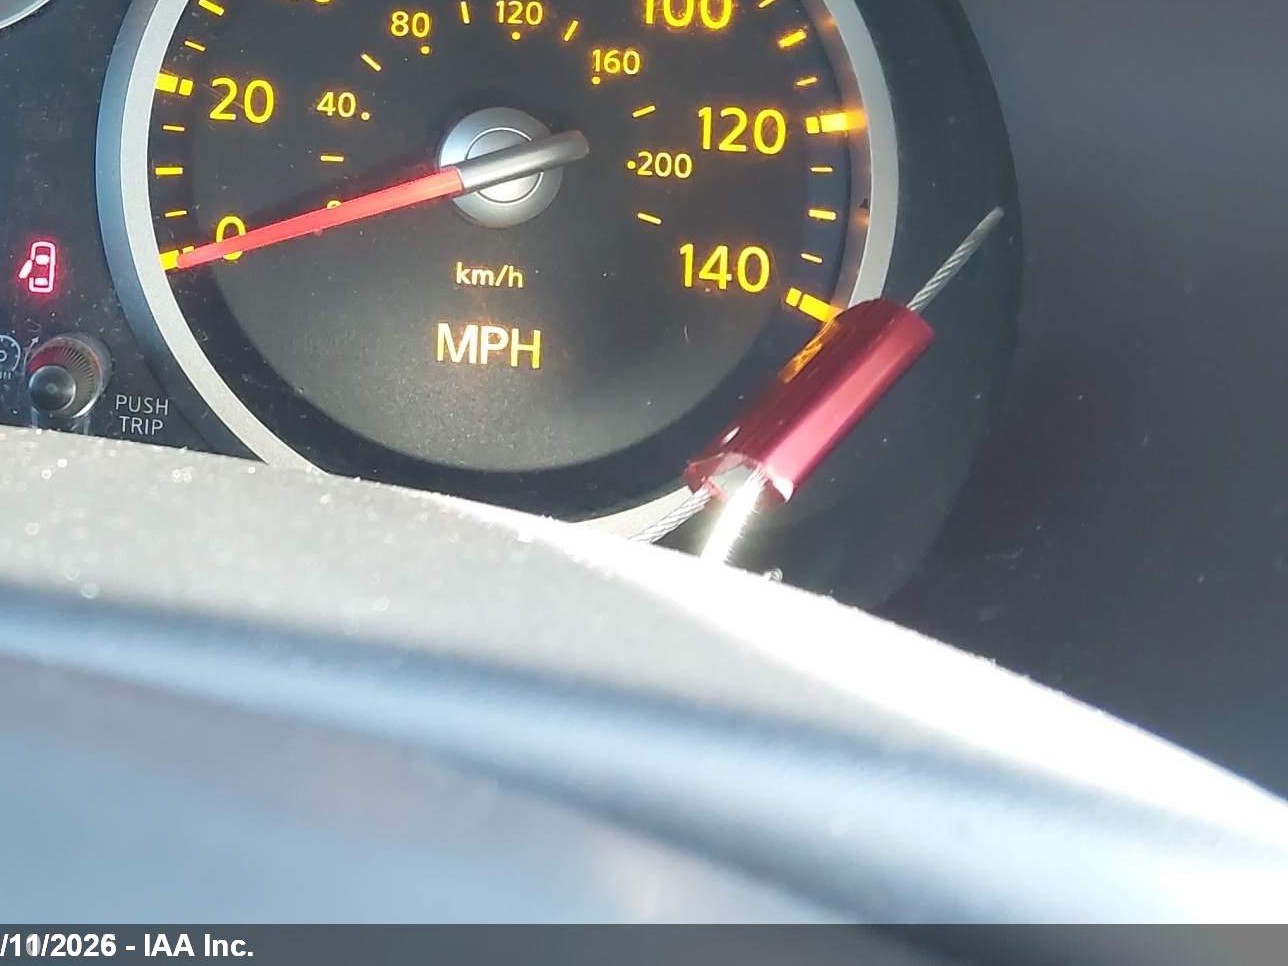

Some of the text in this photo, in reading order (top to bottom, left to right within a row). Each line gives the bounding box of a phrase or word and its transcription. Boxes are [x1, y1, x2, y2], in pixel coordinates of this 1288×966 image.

[391, 11, 430, 37] 80
[496, 0, 544, 26] 120
[592, 48, 640, 75] 160
[210, 78, 275, 123] 20
[316, 92, 356, 118] 40
[698, 107, 786, 155] 120
[637, 153, 692, 178] 200
[455, 262, 524, 288] km/h
[679, 244, 770, 292] 140
[437, 323, 542, 369] MPH
[116, 395, 168, 414] PUSH
[119, 416, 163, 435] TRIP
